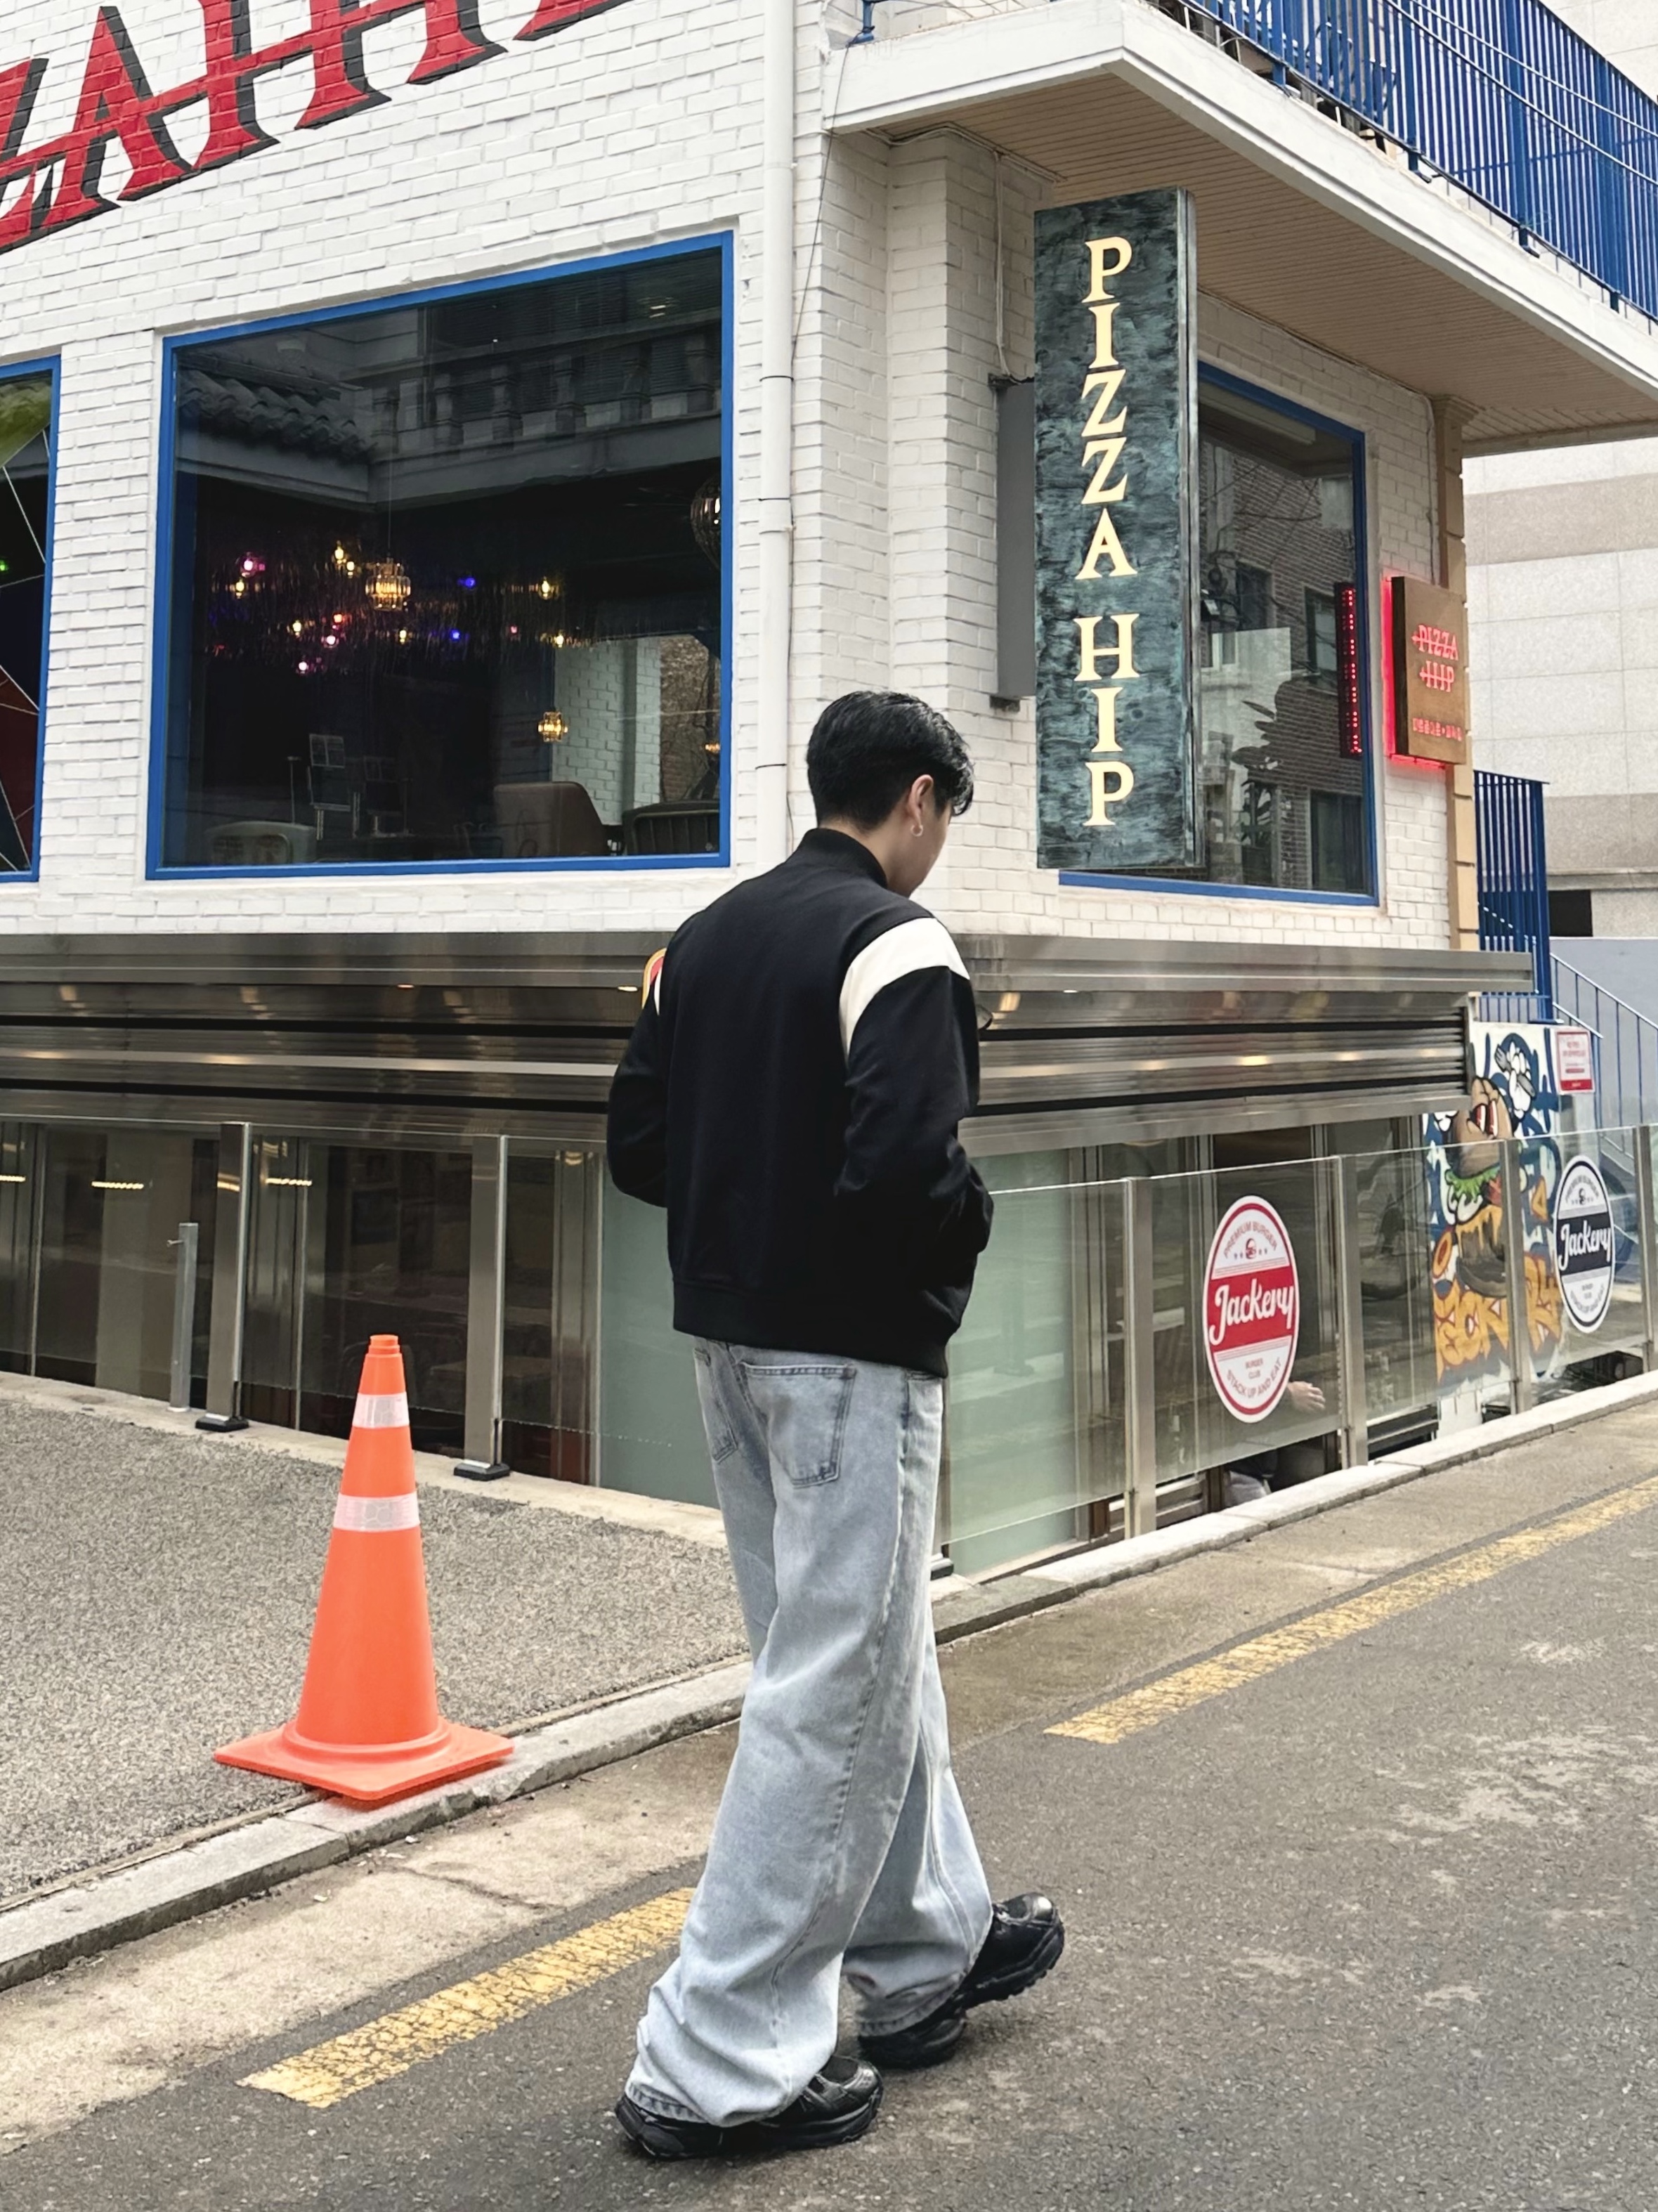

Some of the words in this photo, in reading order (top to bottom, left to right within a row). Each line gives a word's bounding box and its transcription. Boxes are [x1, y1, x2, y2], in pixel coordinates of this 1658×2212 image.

[1075, 236, 1137, 580] PIZZA
[1414, 624, 1458, 661] PIZZA
[1421, 660, 1454, 693] HIP
[1073, 613, 1140, 826] HIP
[1558, 1220, 1612, 1271] Jackery
[1209, 1278, 1293, 1346] Jackery
